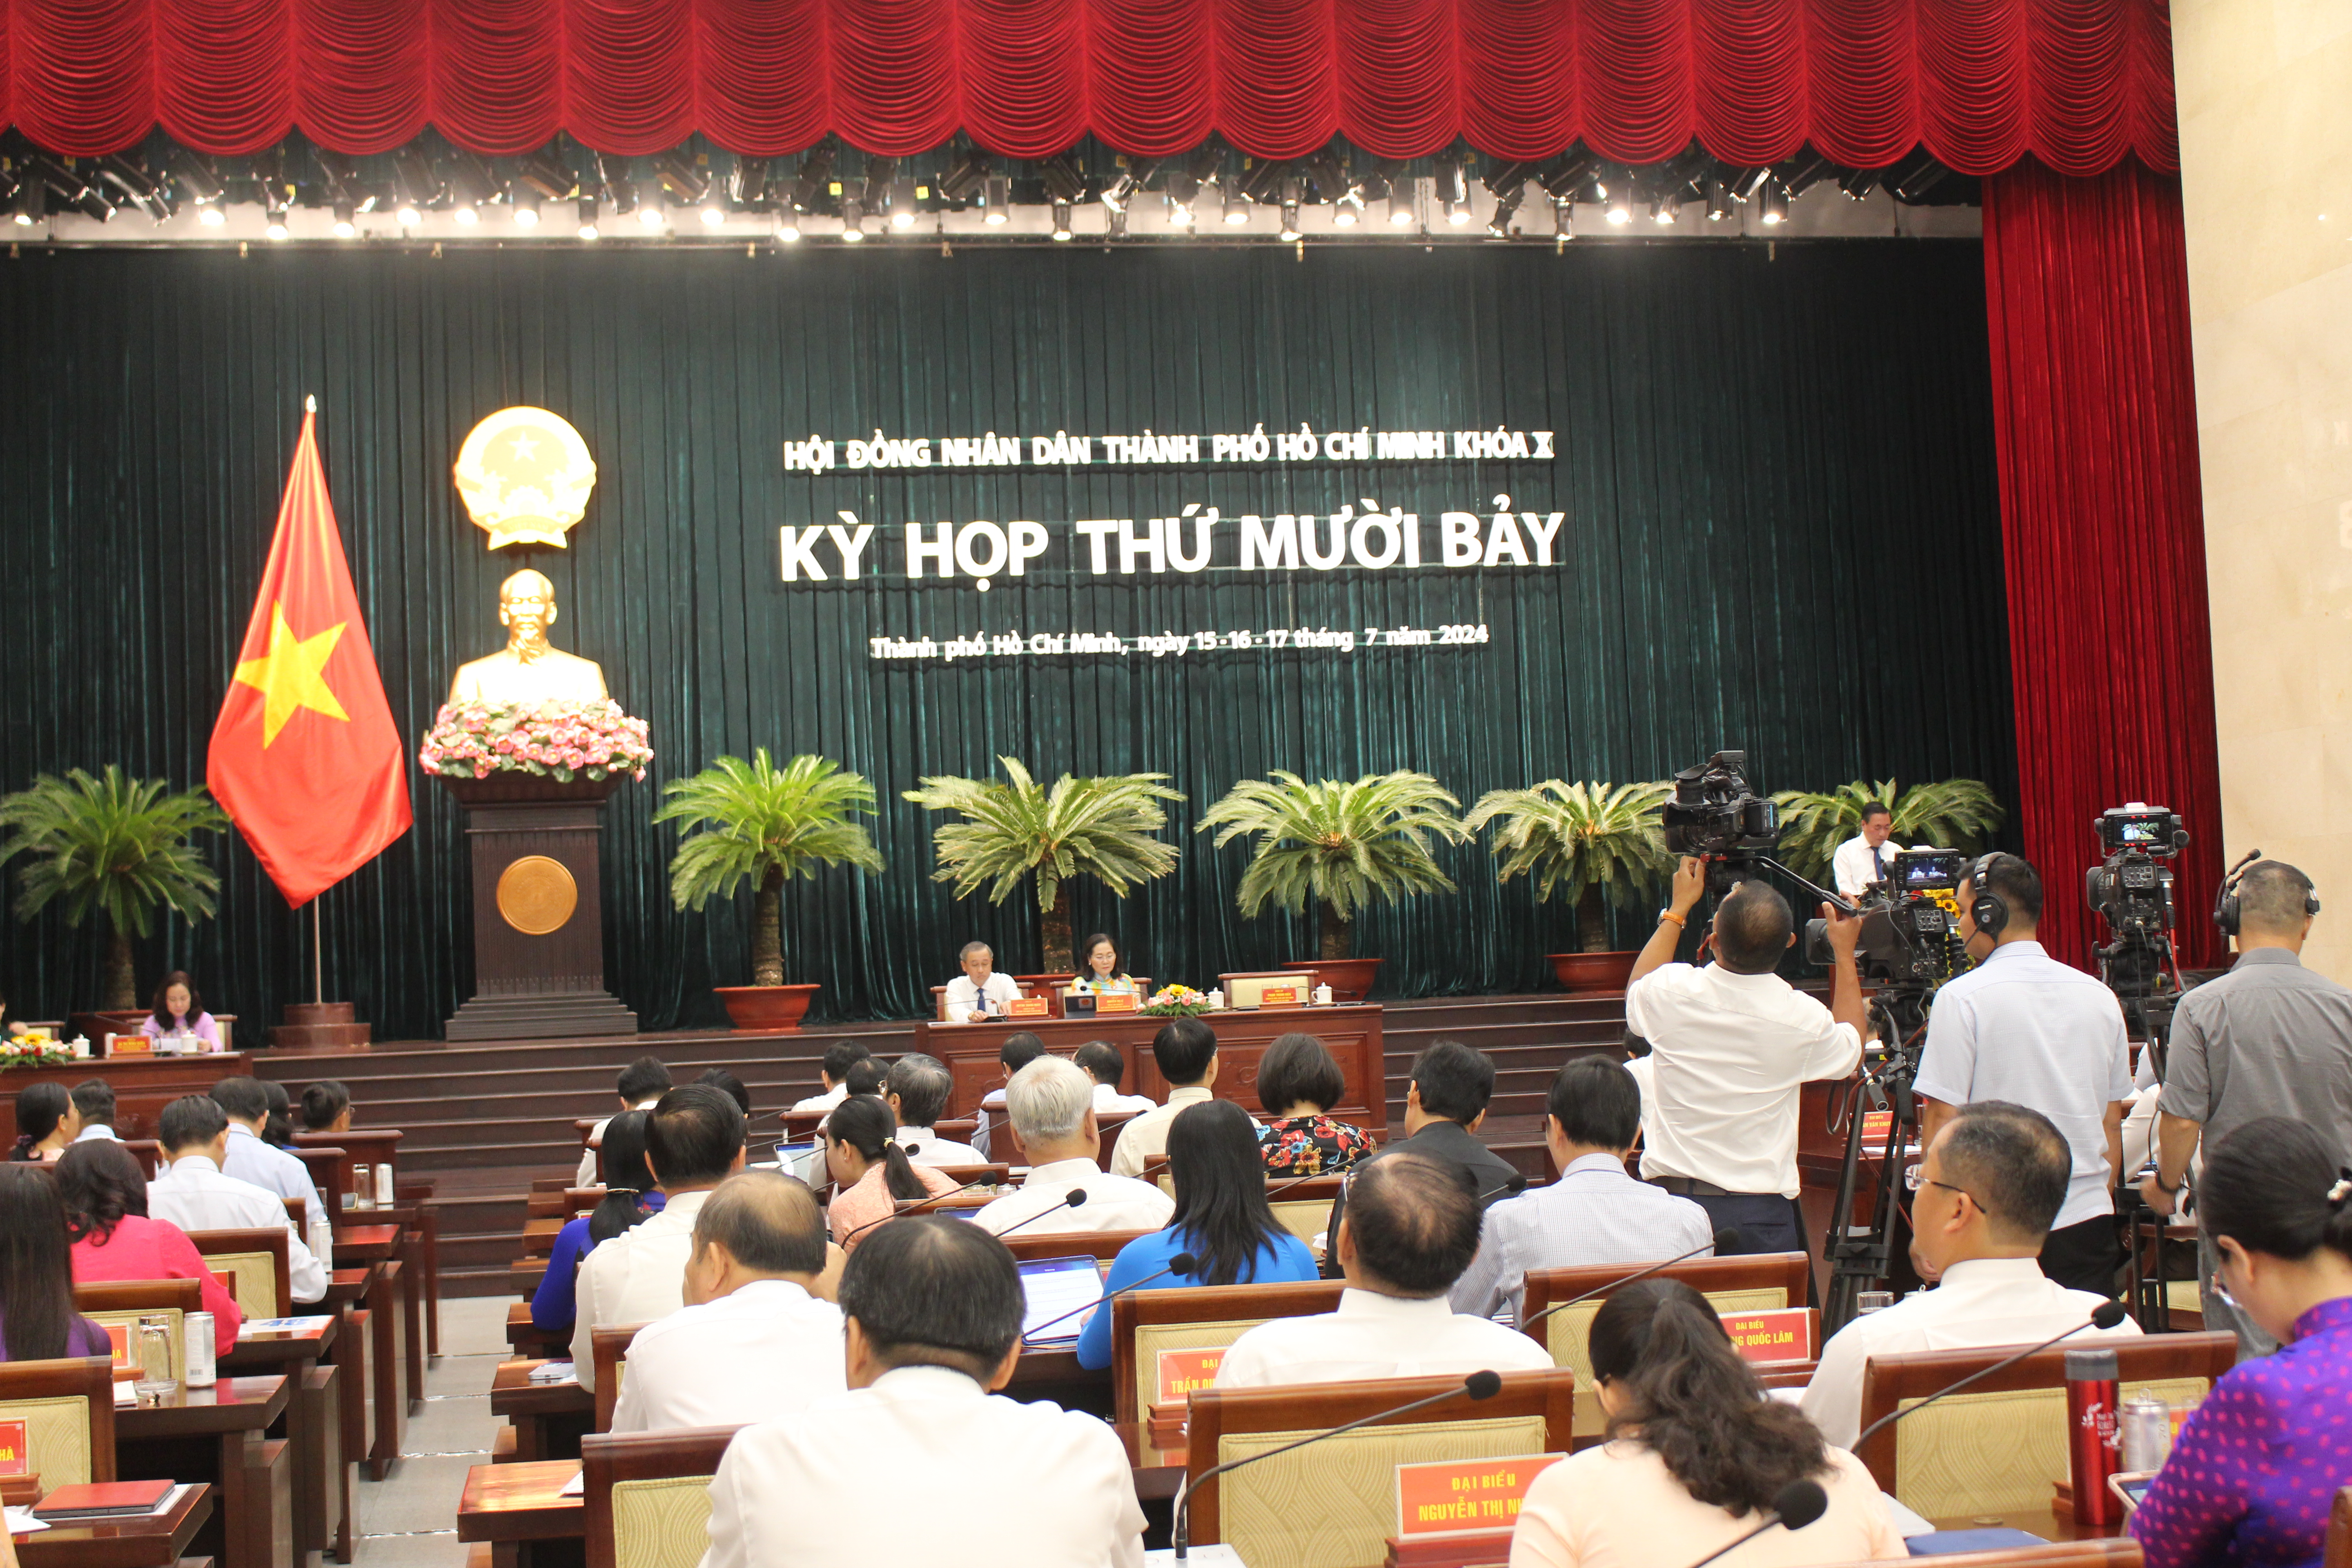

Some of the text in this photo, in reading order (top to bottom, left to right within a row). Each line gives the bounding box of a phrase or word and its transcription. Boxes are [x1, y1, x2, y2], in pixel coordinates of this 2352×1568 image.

[784, 422, 1555, 475] HỘI ĐỒNG NHÂN DÂN THÀNH PHỐ HỒ CHÍ MINH KHÓA X
[780, 494, 1565, 592] KỲ HỌP THỨ MƯỜI BẢY
[870, 636, 938, 659] Thành
[944, 631, 988, 662] phố
[993, 630, 1024, 656] Hồ
[1029, 633, 1066, 654] Chí
[1137, 630, 1191, 657] ngày
[1294, 626, 1354, 652] tháng
[1364, 627, 1378, 647] 7
[1385, 625, 1432, 646] năm
[1438, 624, 1489, 645] 2024
[1735, 1318, 1764, 1332] ĐẠI BIỂU
[1746, 1330, 1771, 1347] QUỐC
[1773, 1330, 1793, 1344] LÂM
[1202, 1358, 1219, 1370] ĐẠI
[1171, 1375, 1200, 1394] TRẦN
[1451, 1469, 1516, 1492] ĐẠI BIỂU
[1418, 1496, 1478, 1521] NGUYỄN
[1481, 1499, 1504, 1519] THỊ
